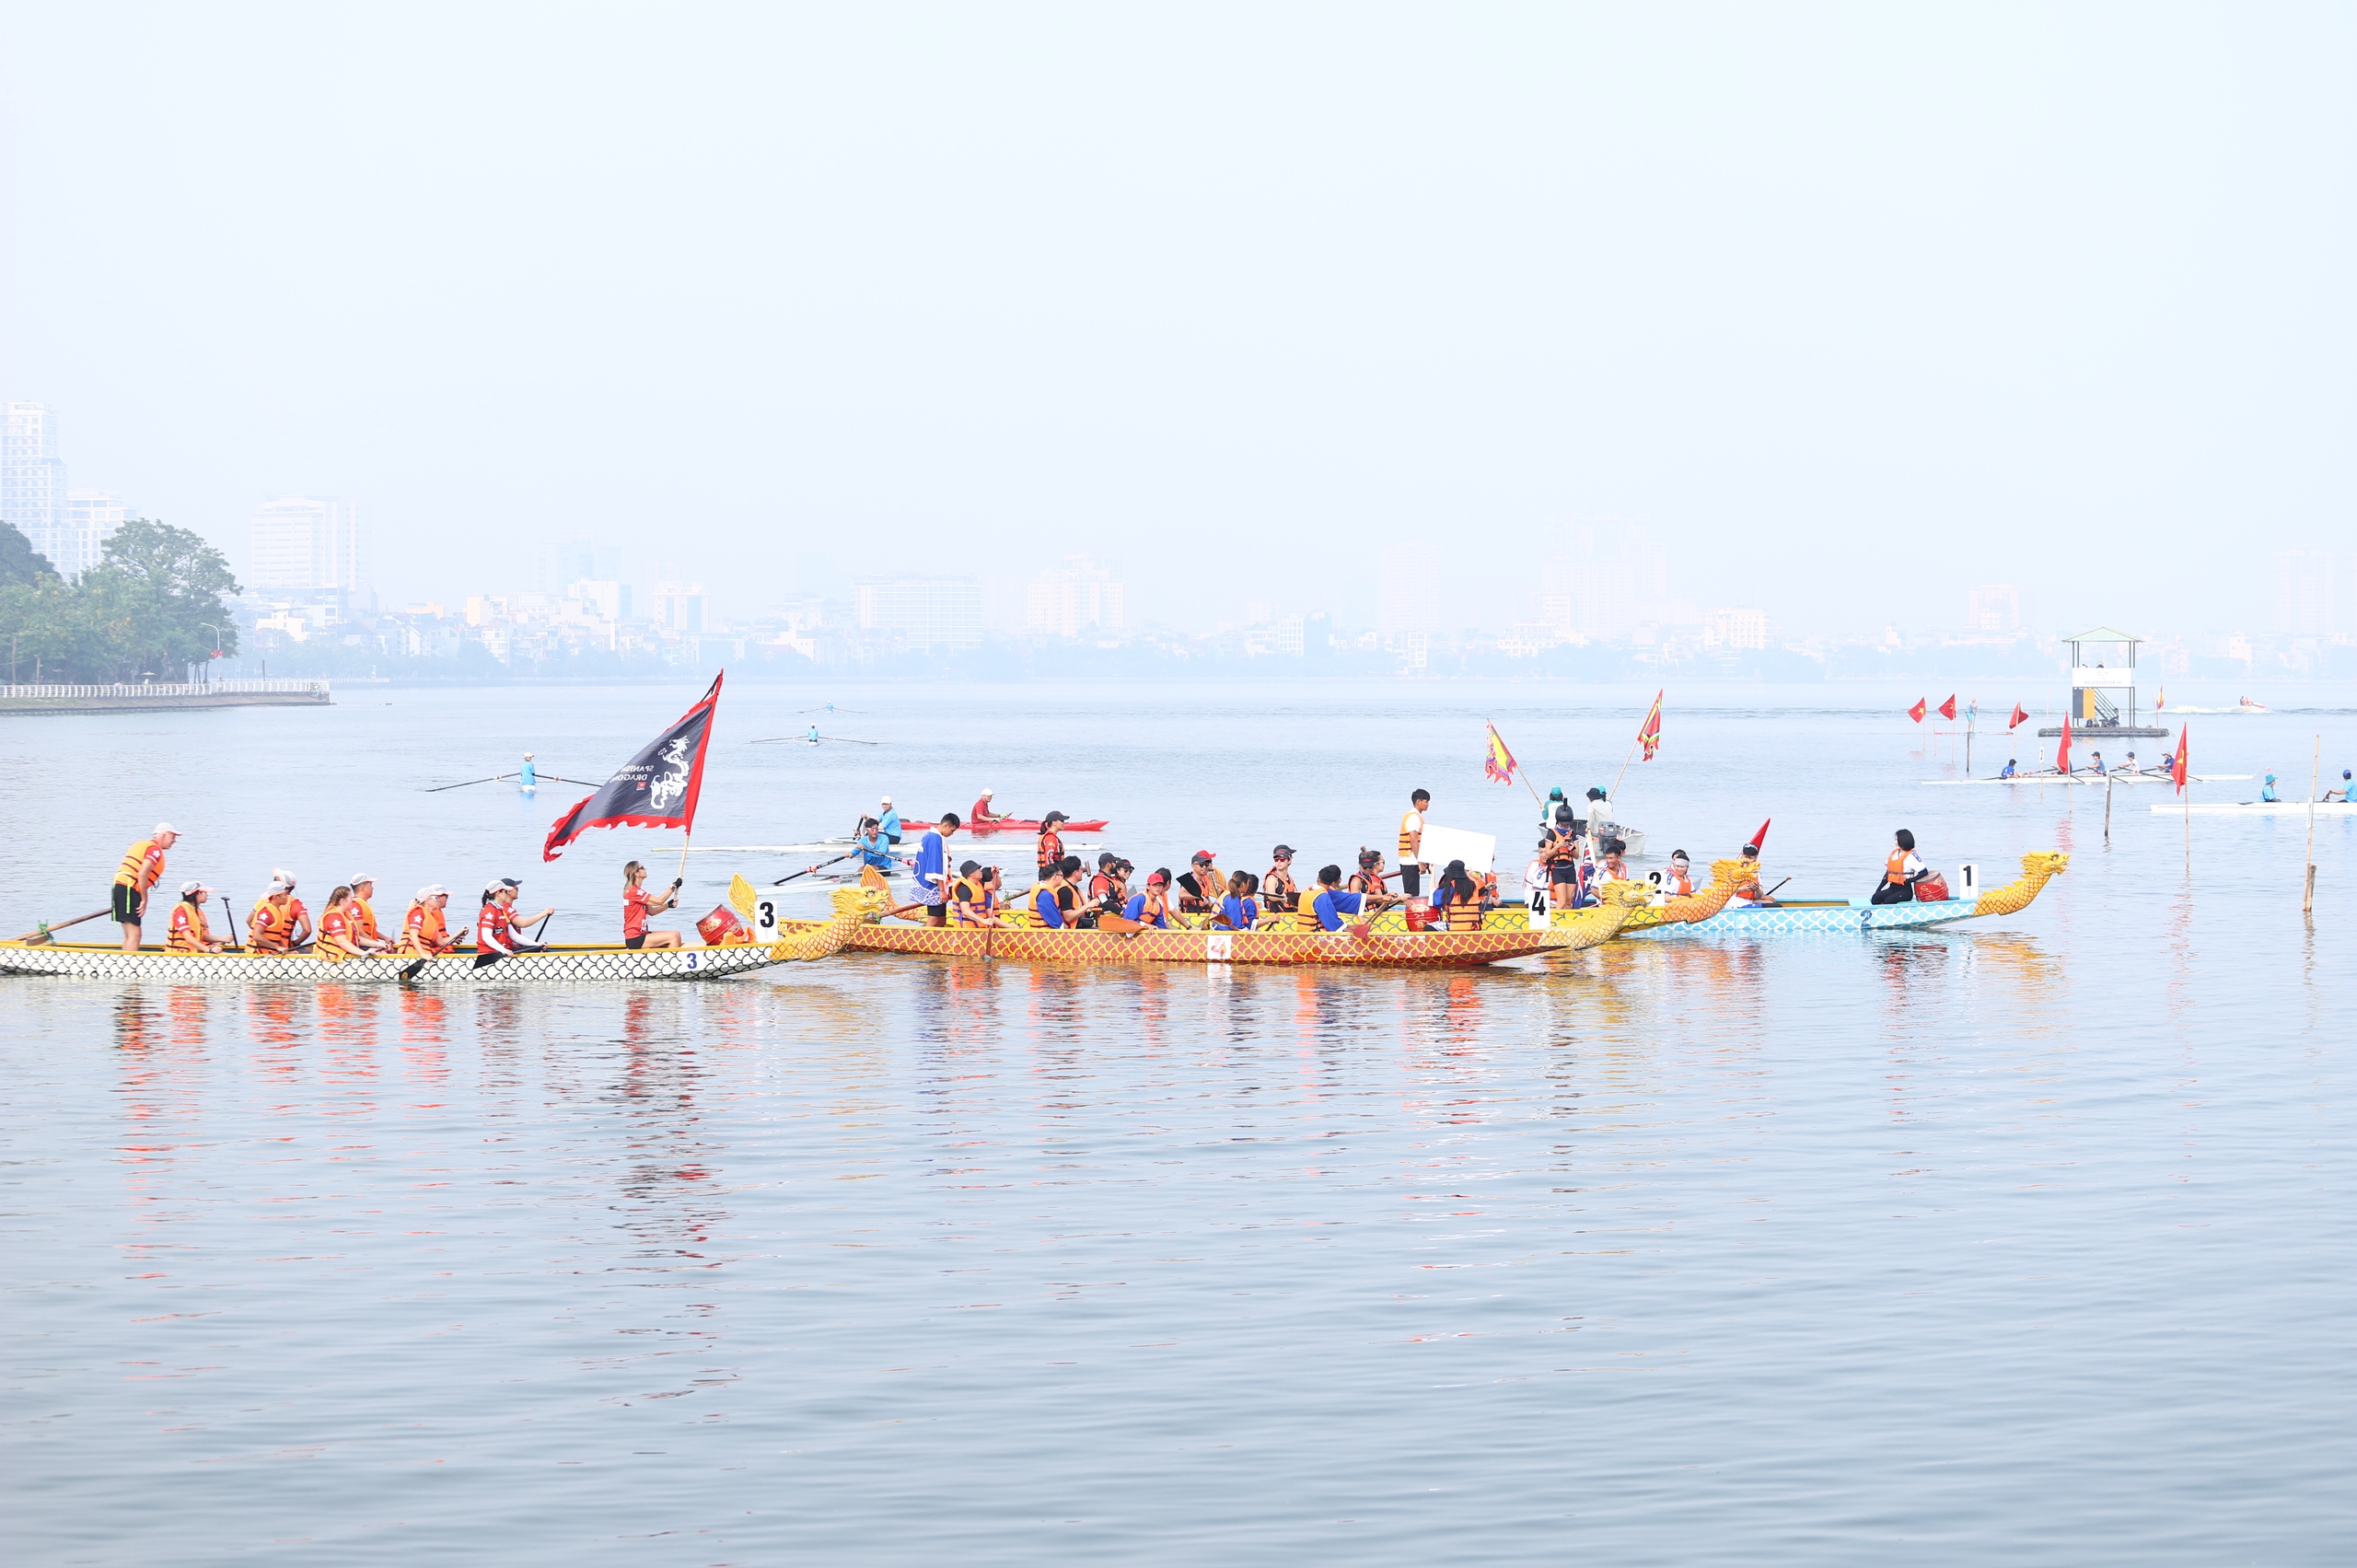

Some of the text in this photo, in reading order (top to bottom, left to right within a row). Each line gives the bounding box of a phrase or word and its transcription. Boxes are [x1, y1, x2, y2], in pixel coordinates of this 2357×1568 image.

[1649, 872, 1662, 894] 2
[1963, 865, 1971, 886] 1
[1532, 891, 1546, 915] 4
[761, 901, 774, 928] 3
[1861, 909, 1873, 928] 2
[687, 952, 698, 970] 3
